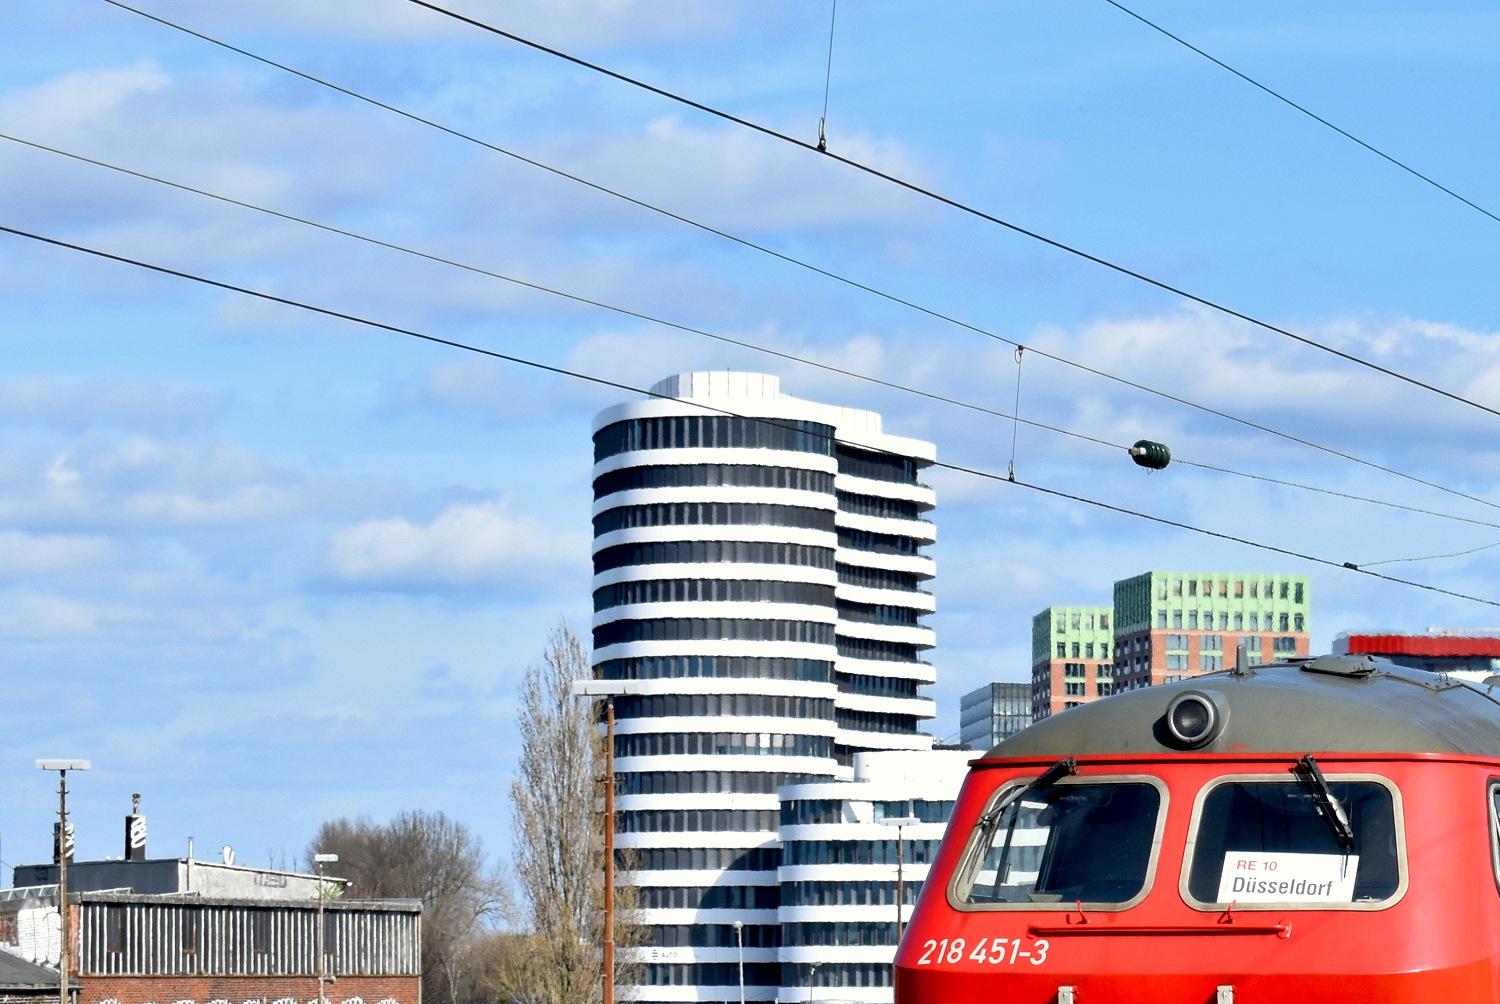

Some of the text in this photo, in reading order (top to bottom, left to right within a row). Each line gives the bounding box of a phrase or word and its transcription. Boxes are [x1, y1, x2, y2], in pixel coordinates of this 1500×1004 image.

[1236, 859, 1278, 871] RE 10
[1232, 877, 1333, 896] Düsseldorf
[917, 938, 1050, 965] 218 451-3
